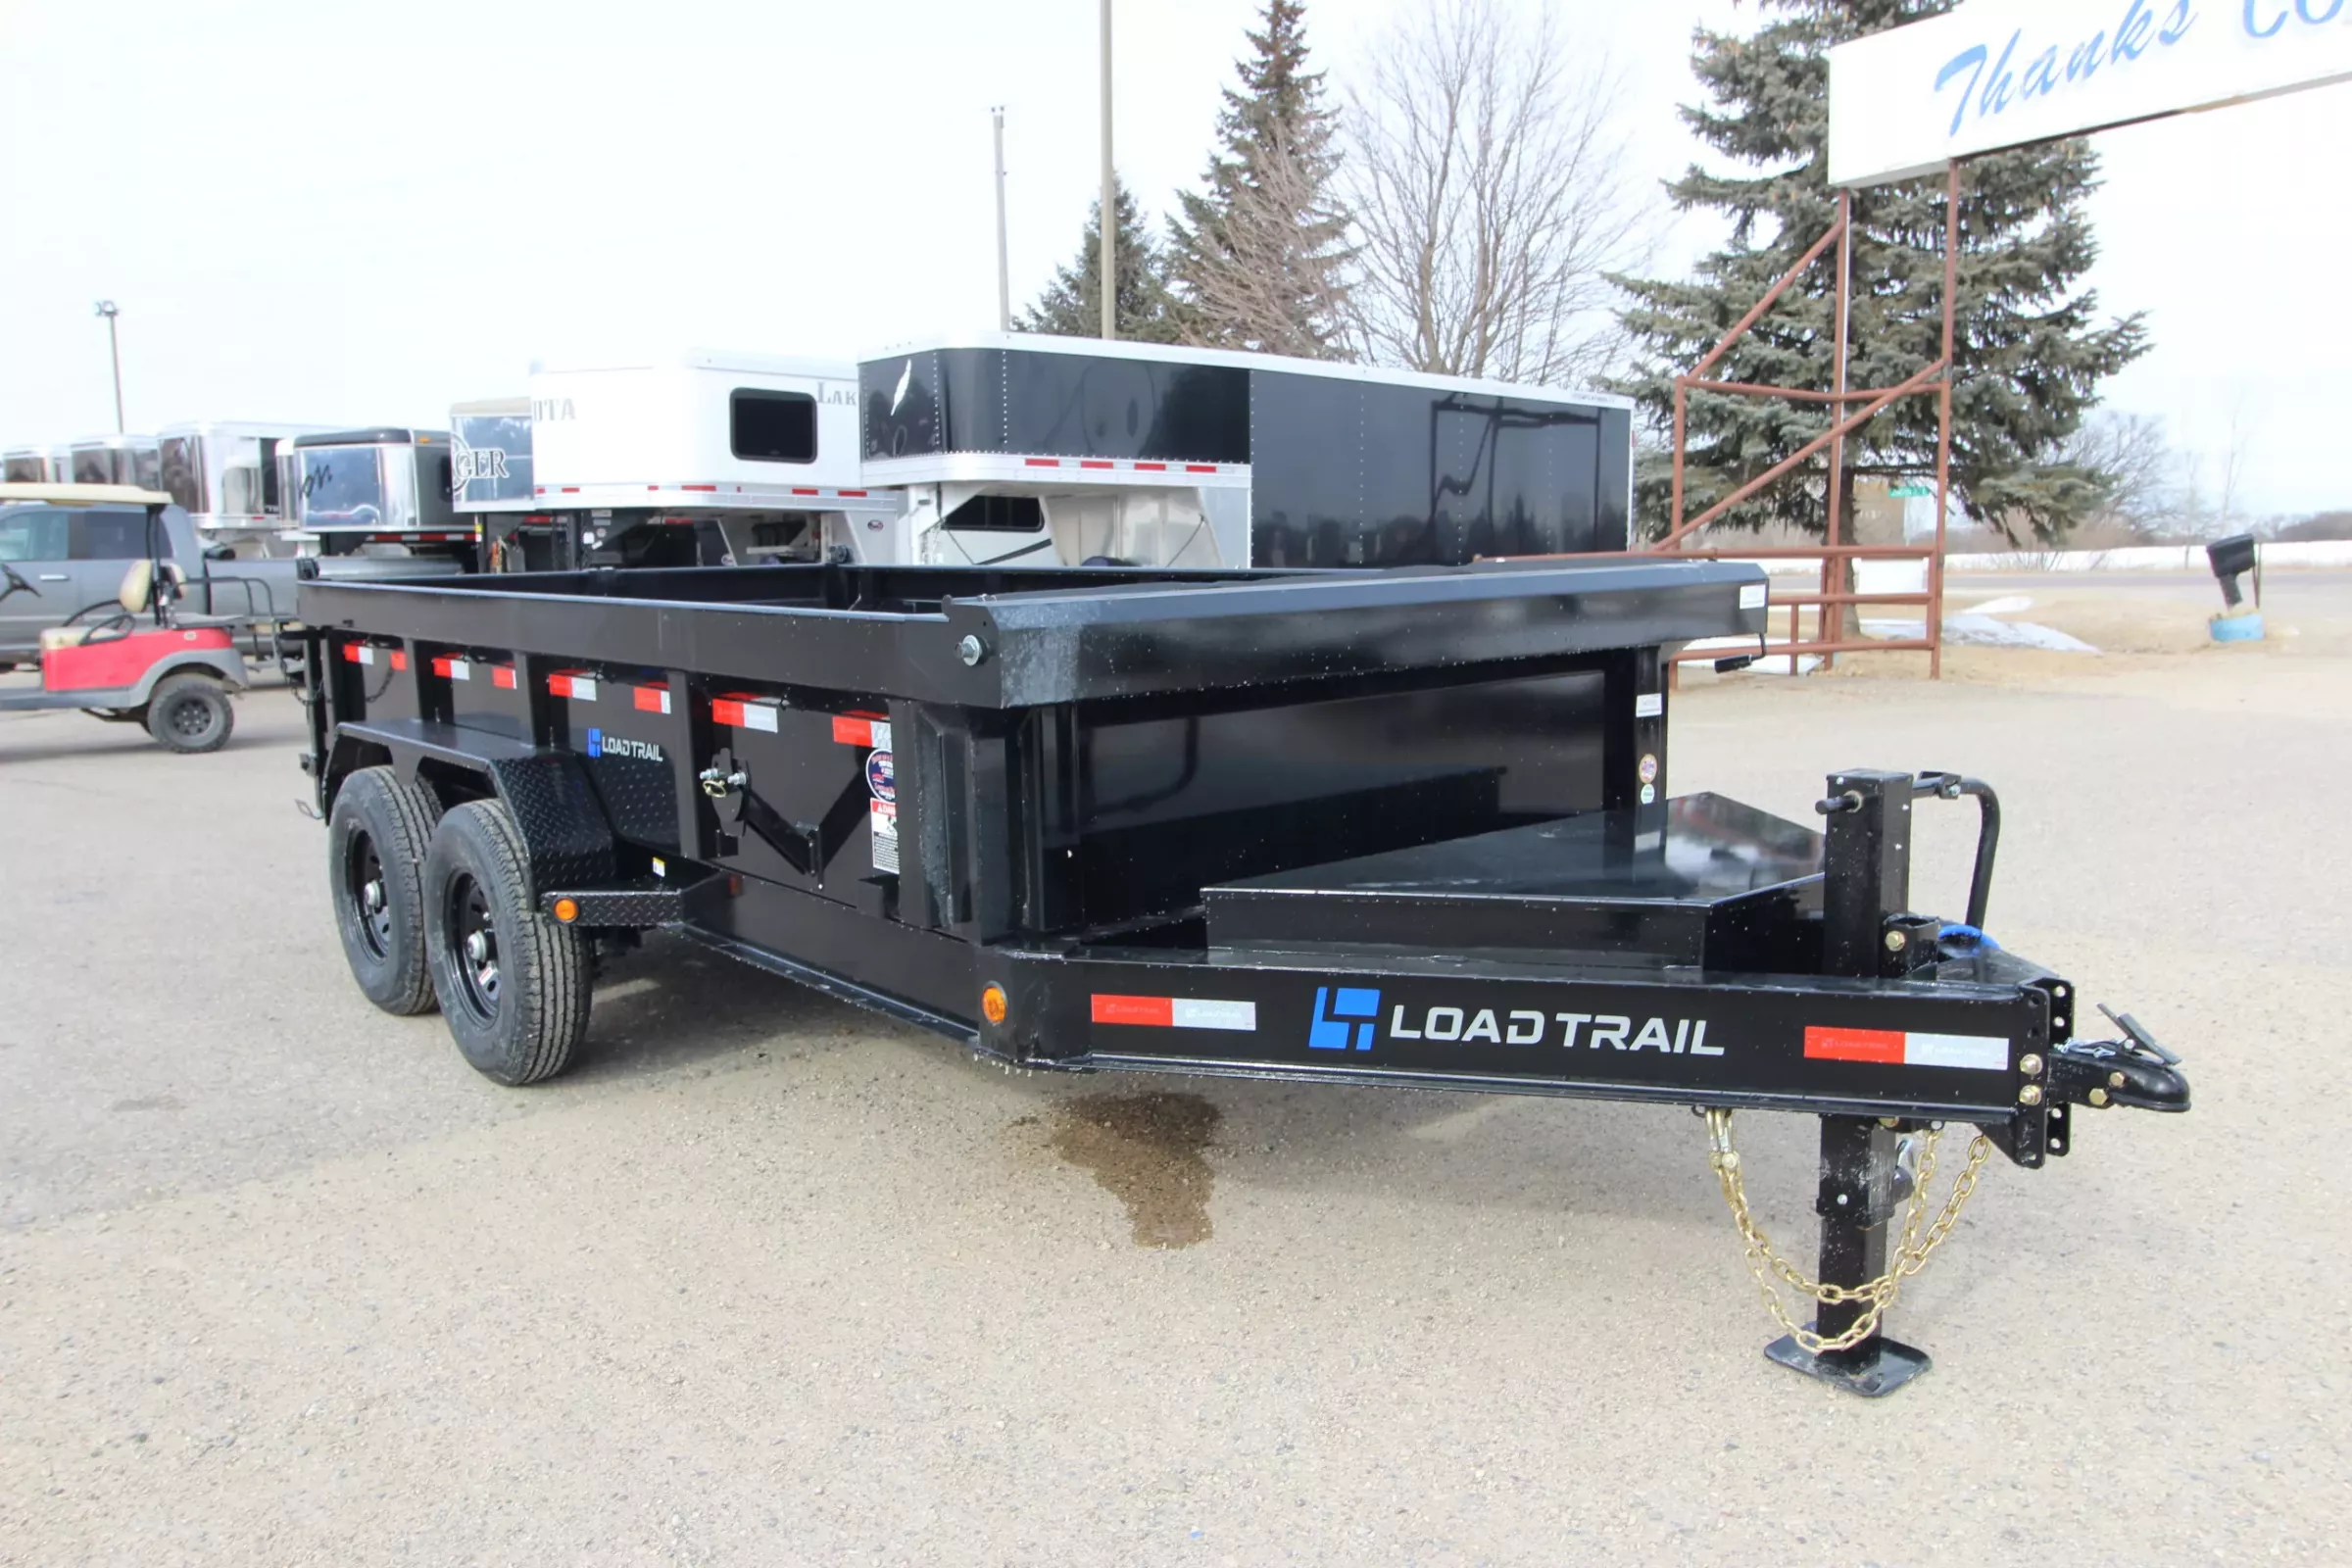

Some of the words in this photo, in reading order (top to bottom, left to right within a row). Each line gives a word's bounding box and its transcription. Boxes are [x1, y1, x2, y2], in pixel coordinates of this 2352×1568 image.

[1935, 0, 2199, 138] Thanks
[602, 736, 630, 757] LOAD
[631, 741, 663, 762] TRAIL
[1390, 1004, 1545, 1045] LOAD
[1555, 1012, 1725, 1056] TRAIL
